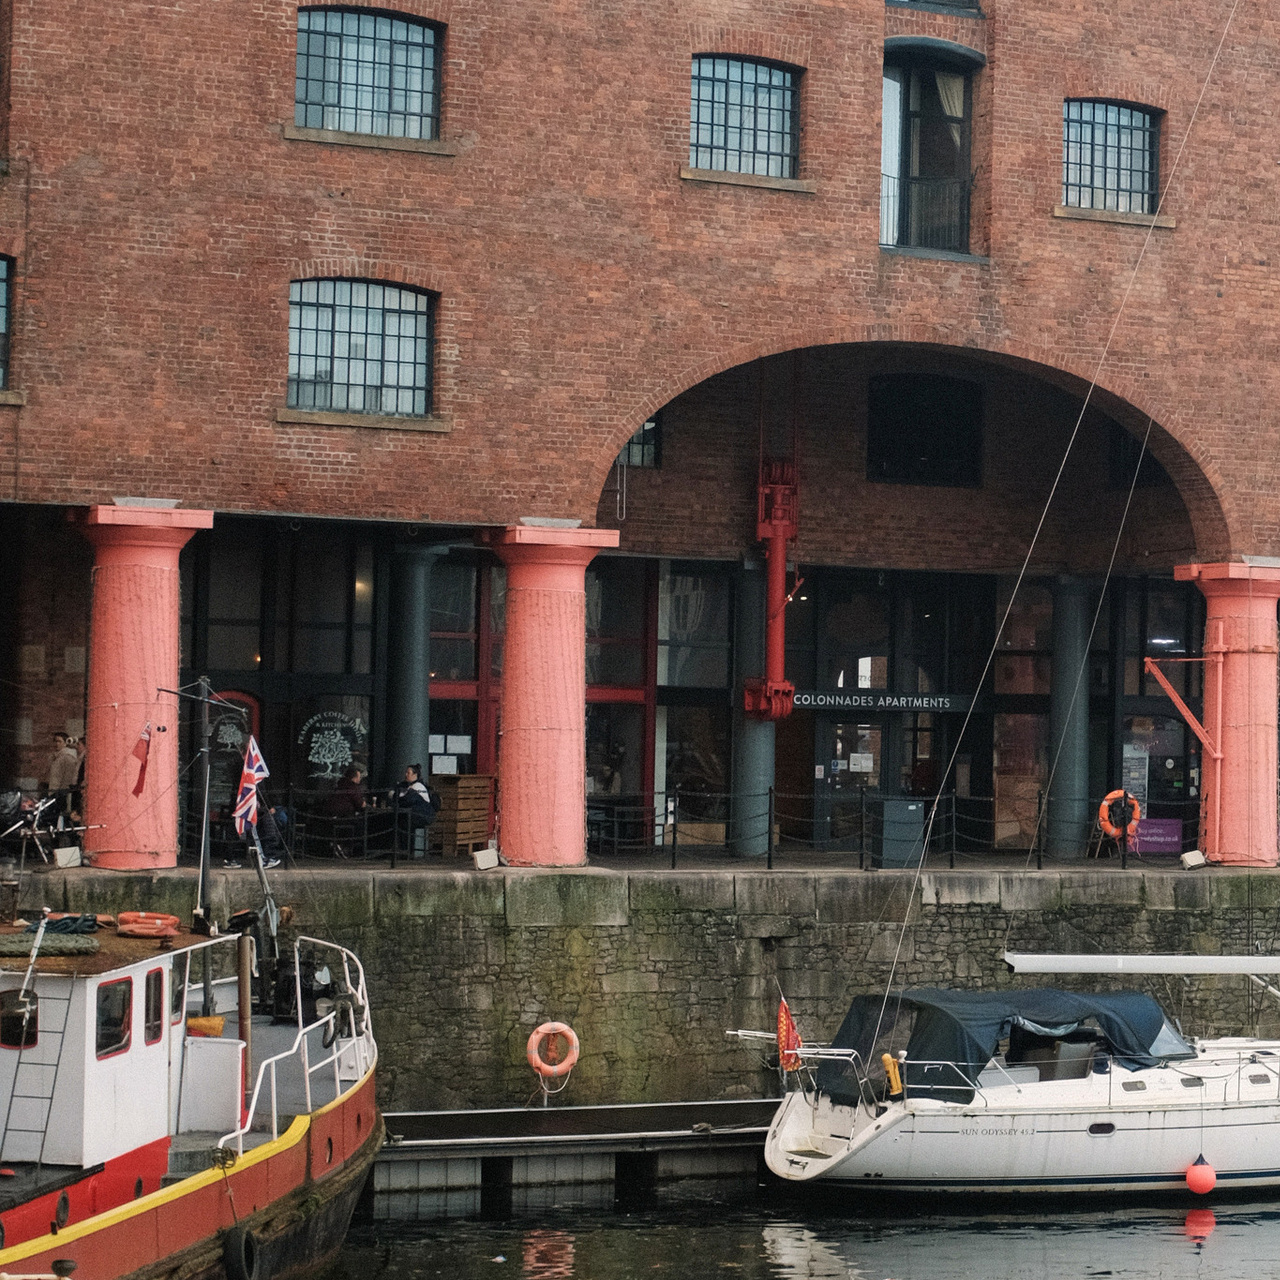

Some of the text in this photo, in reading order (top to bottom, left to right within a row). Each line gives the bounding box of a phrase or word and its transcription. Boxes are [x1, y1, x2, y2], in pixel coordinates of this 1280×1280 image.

[794, 694, 950, 708] COLONNADES APARTMENTS
[961, 1128, 1035, 1136] SUN ODYSSEY 45.2
